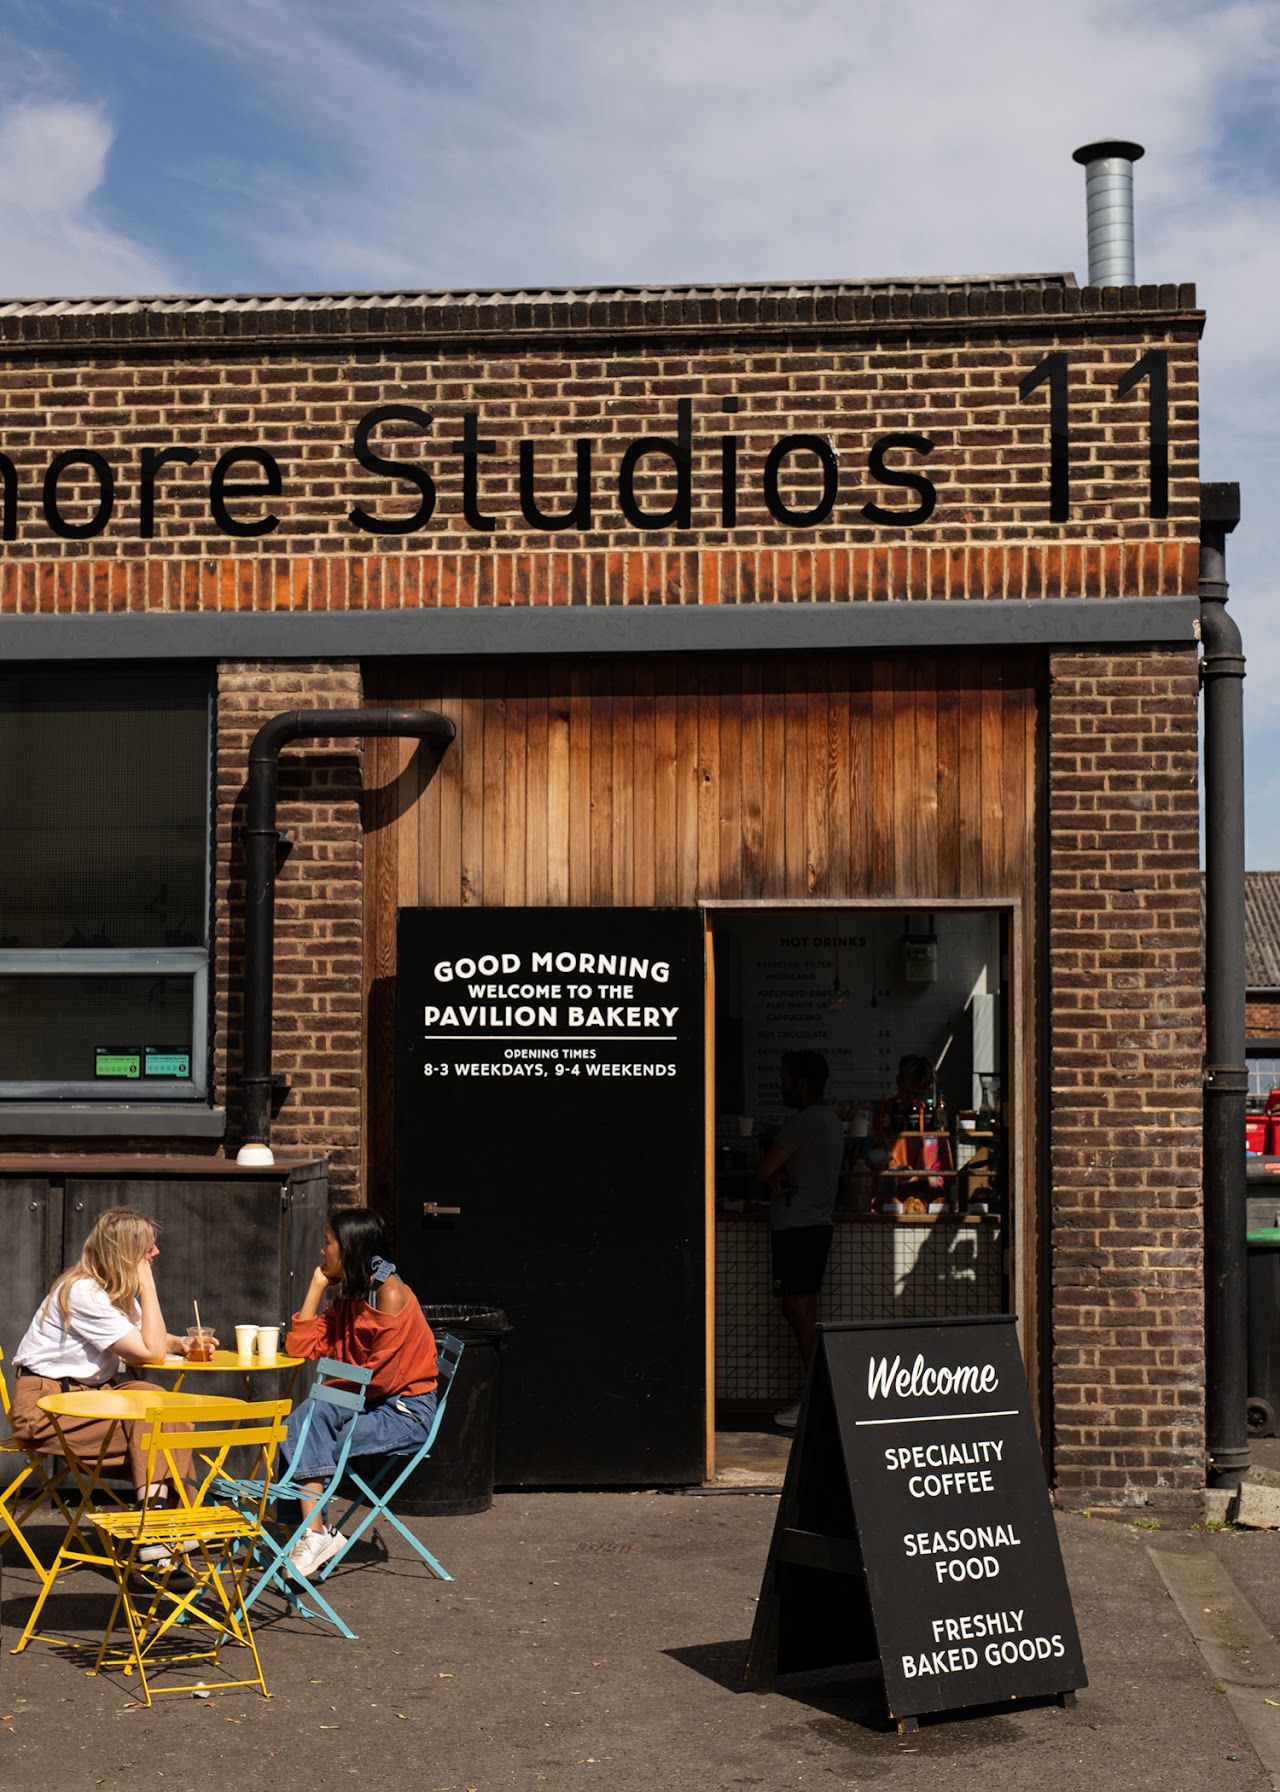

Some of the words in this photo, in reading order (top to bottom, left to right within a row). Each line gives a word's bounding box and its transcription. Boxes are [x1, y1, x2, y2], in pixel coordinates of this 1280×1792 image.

[0, 446, 283, 540] ore
[348, 396, 938, 536] Studios
[1018, 350, 1169, 523] 11
[780, 936, 809, 948] HOT
[813, 936, 866, 948] DRINKS
[433, 953, 521, 982] GOOD
[531, 952, 670, 983] MORNING
[468, 984, 562, 999] WELCOME
[567, 985, 592, 999] TO
[598, 985, 634, 999] THE
[424, 1006, 557, 1026] PAVILION
[568, 1006, 680, 1027] BAKERY
[504, 1049, 559, 1059] OPENING
[562, 1049, 597, 1059] TIMES
[423, 1063, 449, 1076] 8-3
[455, 1063, 548, 1078] WEEKDAYS,
[555, 1063, 581, 1076] 9-4
[586, 1063, 677, 1076] WEEKENDS
[867, 1353, 999, 1401] Welcome
[885, 1440, 1004, 1471] SPECIALITY
[908, 1470, 995, 1499] COFFEE
[903, 1524, 1022, 1557] SEASONAL
[935, 1555, 1000, 1584] FOOD
[931, 1609, 1024, 1643] FRESHLY
[902, 1647, 979, 1678] BAKED
[985, 1634, 1066, 1667] GOODS
